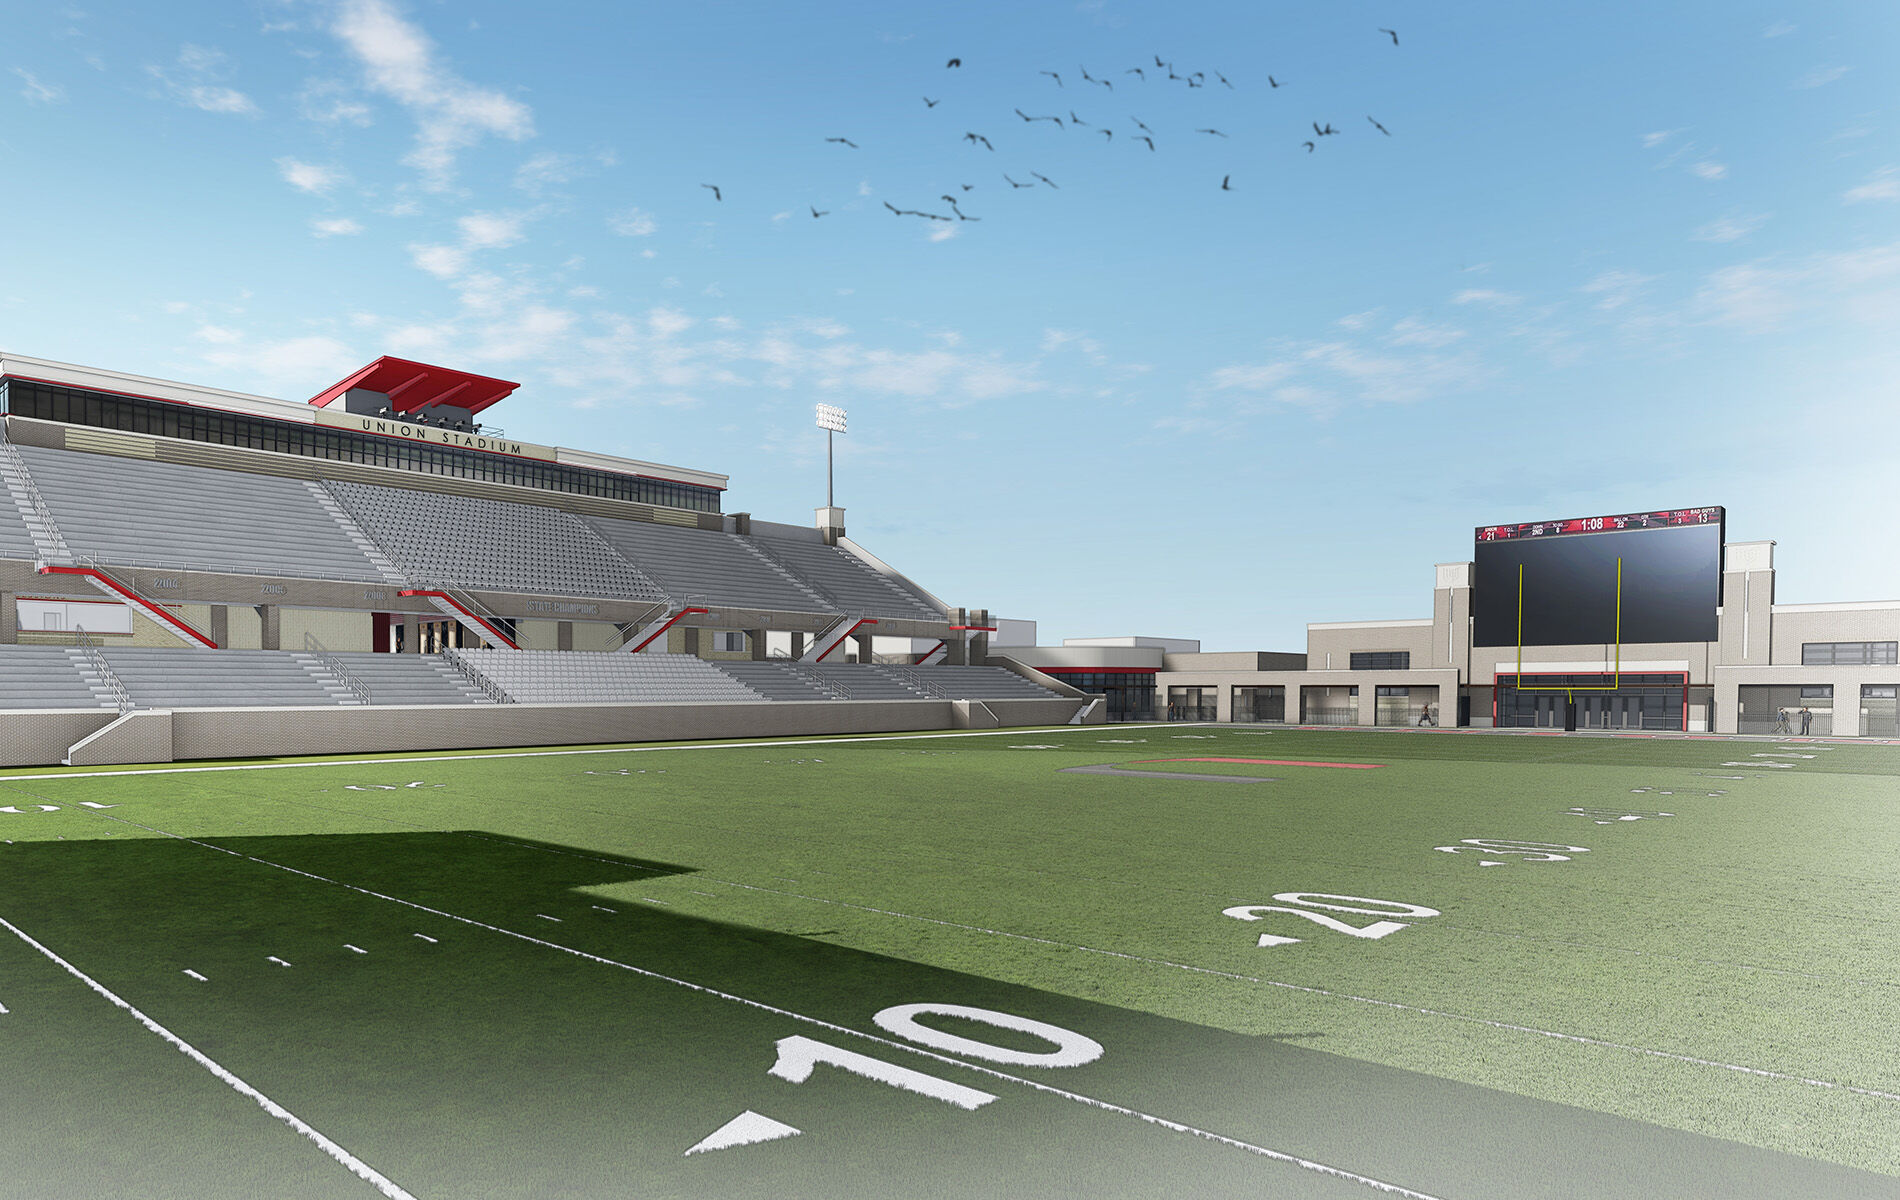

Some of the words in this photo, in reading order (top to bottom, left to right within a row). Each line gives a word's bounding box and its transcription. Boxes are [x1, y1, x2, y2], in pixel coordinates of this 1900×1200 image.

[362, 419, 426, 438] UNION
[442, 432, 521, 454] STADIUM
[1642, 519, 1647, 527] 2
[1697, 513, 1708, 523] 13
[1581, 517, 1603, 531] 1:08
[1616, 521, 1625, 529] 22
[1486, 532, 1495, 541] 21
[1531, 528, 1544, 536] 2ND
[1222, 892, 1441, 940] 20
[767, 1002, 1104, 1111] 10
